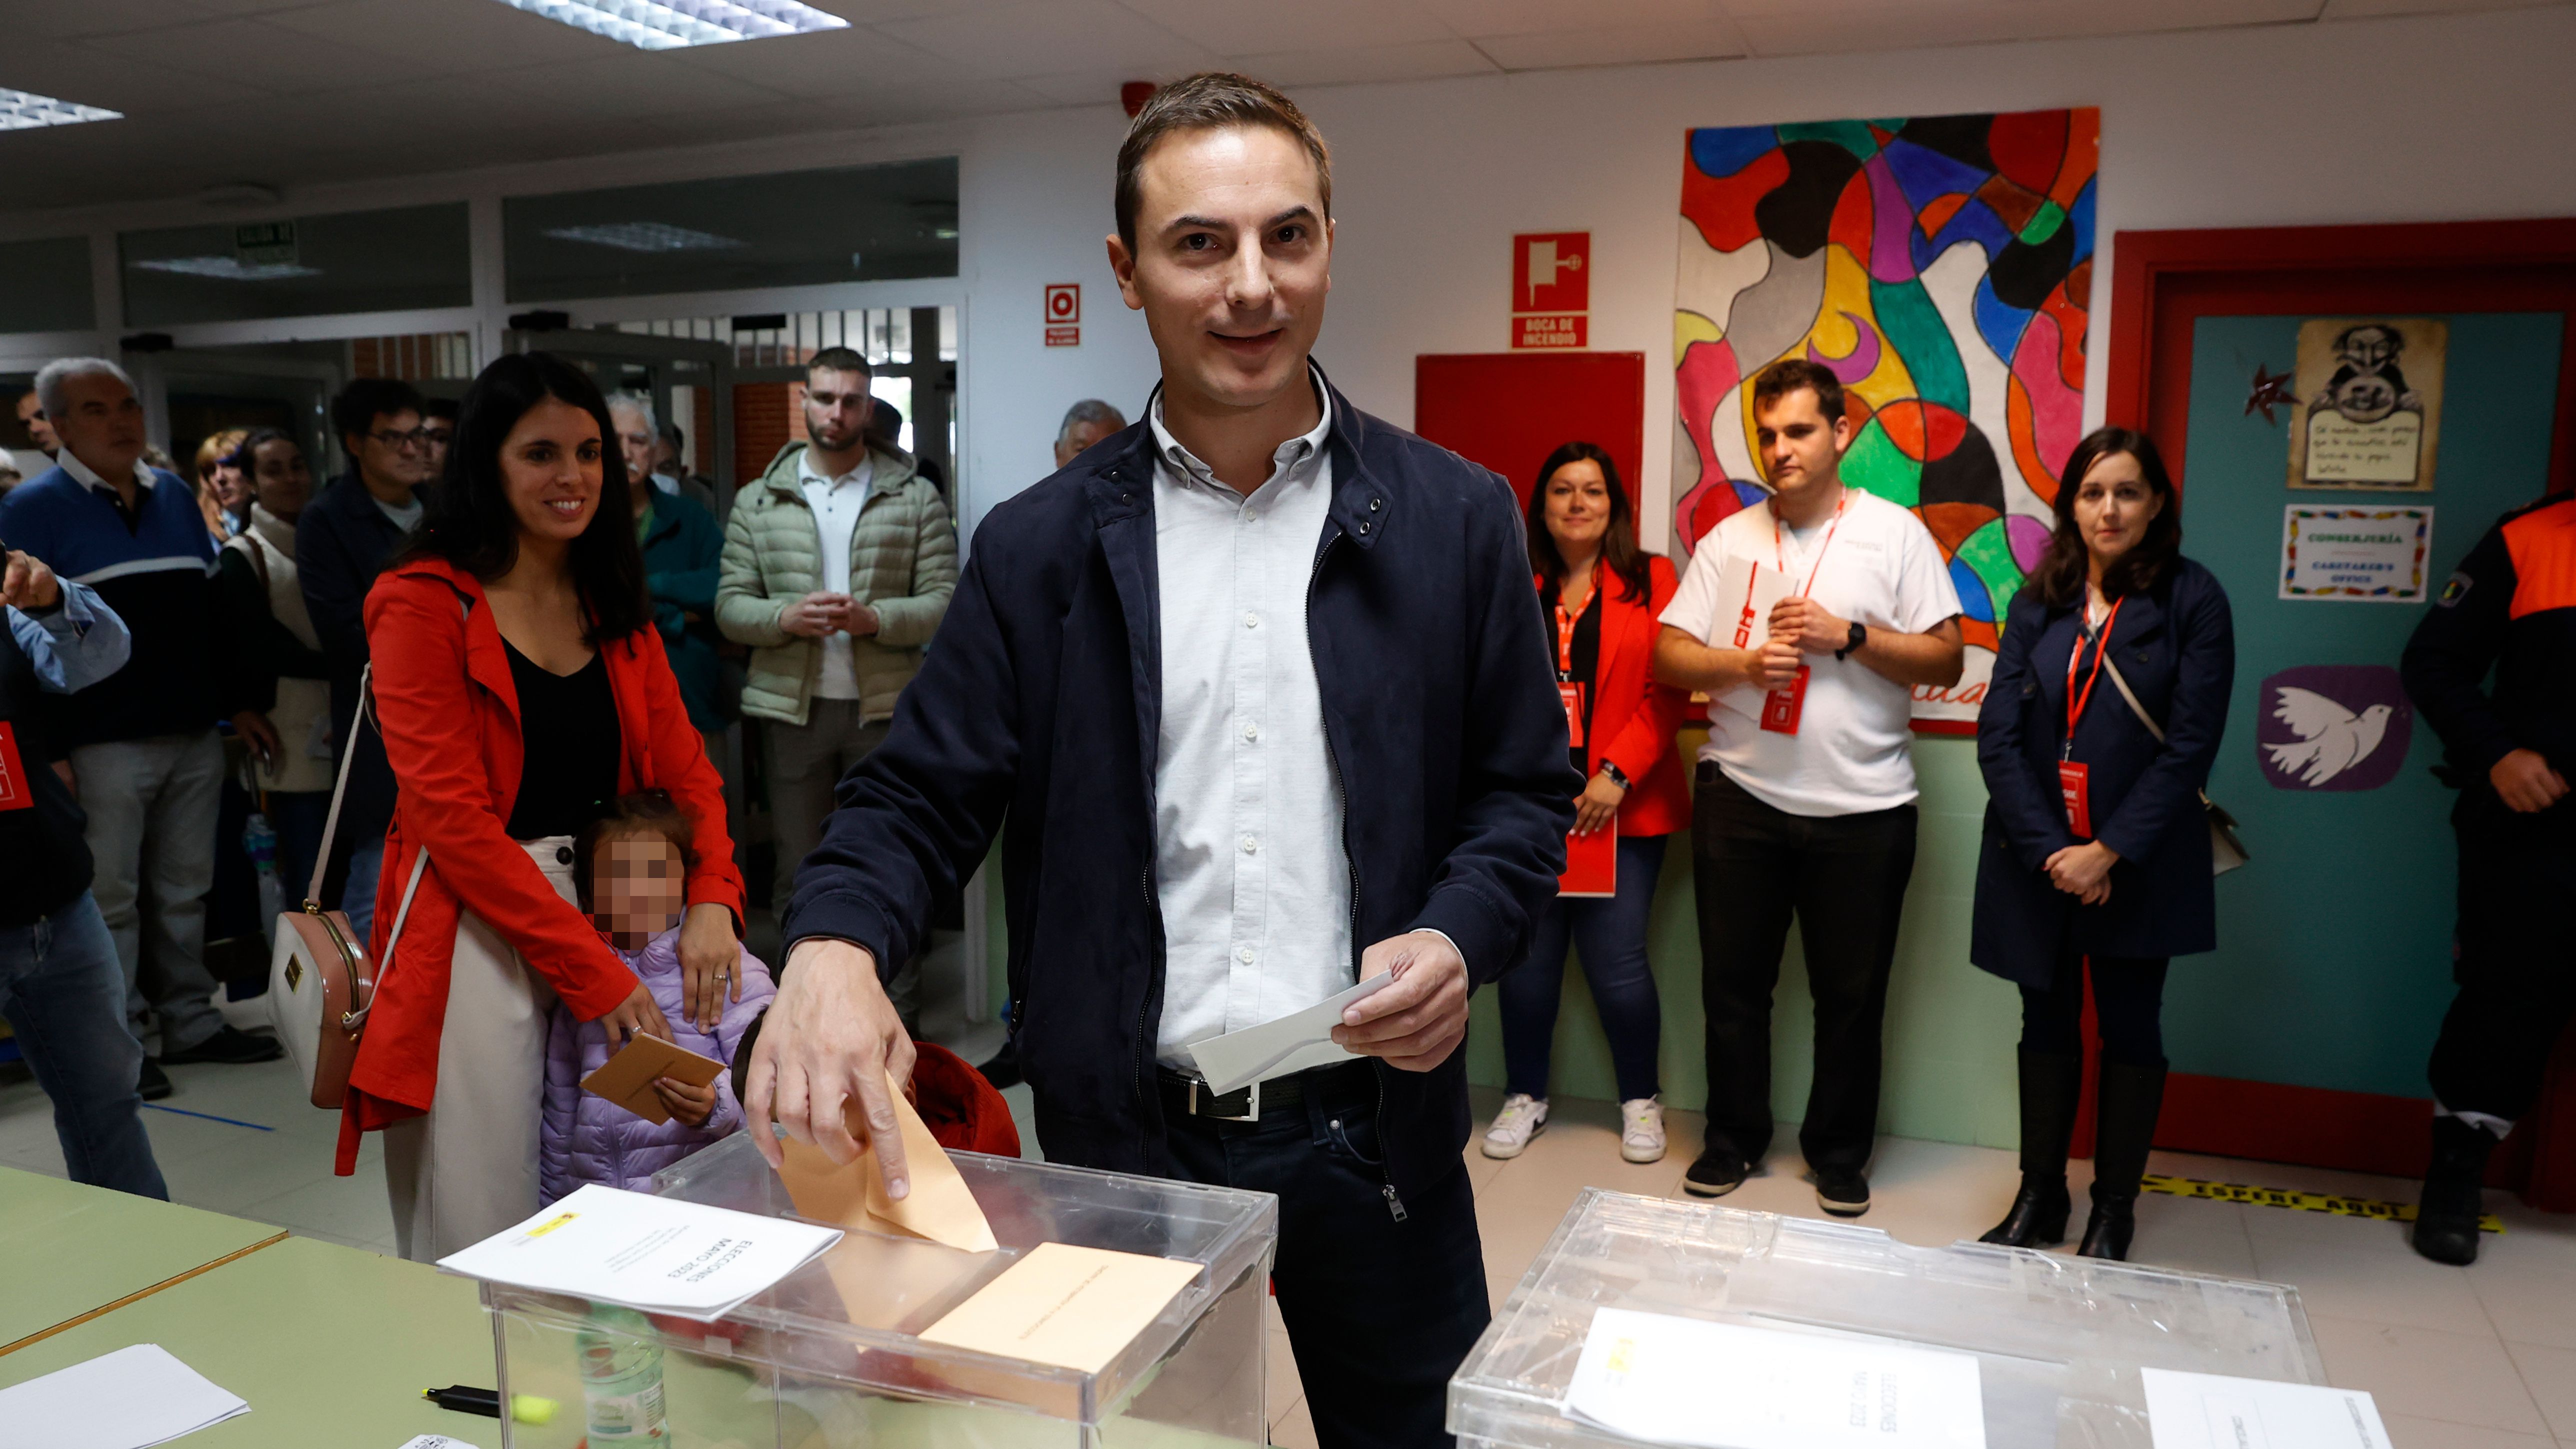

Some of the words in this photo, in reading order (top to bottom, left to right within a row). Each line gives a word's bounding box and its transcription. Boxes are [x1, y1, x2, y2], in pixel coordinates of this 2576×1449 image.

[1526, 318, 1556, 332] BOCA
[1560, 318, 1574, 331] DE
[1523, 332, 1576, 346] INCENDIO
[2196, 1184, 2302, 1204] ESPERE
[696, 1238, 732, 1262] MAYO
[667, 1262, 700, 1278] 2023
[686, 1240, 752, 1282] ELECCIONES
